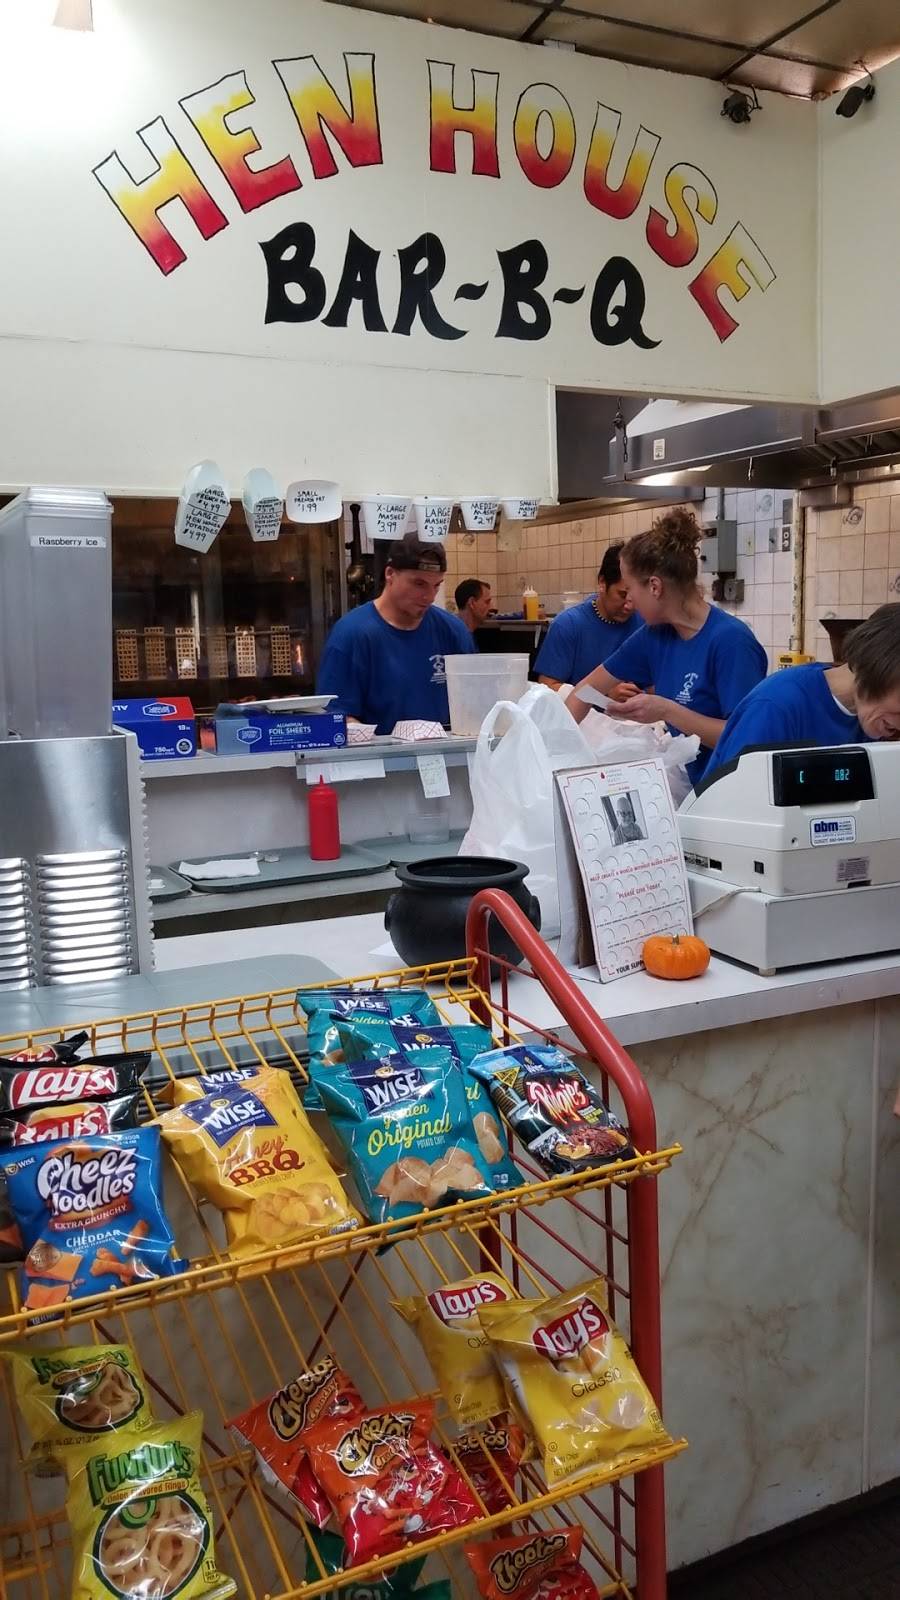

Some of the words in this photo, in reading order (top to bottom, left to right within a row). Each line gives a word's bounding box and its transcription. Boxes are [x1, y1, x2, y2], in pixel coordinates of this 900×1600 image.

[91, 52, 383, 276] HEN
[426, 59, 777, 343] HOUSE
[204, 488, 225, 498] LARGE
[191, 508, 219, 522] LARGE
[377, 504, 407, 513] X-LARGE
[425, 507, 451, 518] LARGE
[186, 513, 202, 523] HEN
[378, 513, 405, 521] MASHED
[377, 520, 397, 533] $3.99
[38, 537, 82, 546] Raspberry
[85, 538, 98, 546] Ice
[268, 727, 285, 735] FOIL
[285, 726, 312, 735] SHEETS
[814, 821, 839, 833] abm
[619, 867, 634, 875] WORLD
[616, 963, 630, 975] YOUR
[339, 999, 388, 1012] WISE
[202, 1068, 254, 1085] WISE
[364, 1072, 419, 1107] WISE
[203, 1099, 264, 1130] WISE
[367, 1112, 453, 1156] Original
[416, 1139, 434, 1149] POTATO
[17, 1156, 36, 1169] WISE
[228, 1149, 306, 1187] BBQ
[37, 1147, 137, 1200] Cheez
[54, 1220, 85, 1231] EXTRA
[84, 1203, 128, 1225] CRUNCHY
[65, 1229, 122, 1248] CHEDDAR
[435, 1283, 497, 1321] Lay's
[537, 1302, 602, 1361] Lay's
[570, 1366, 624, 1399] Classic
[106, 1491, 130, 1504] Onion
[164, 1480, 187, 1492] Rings
